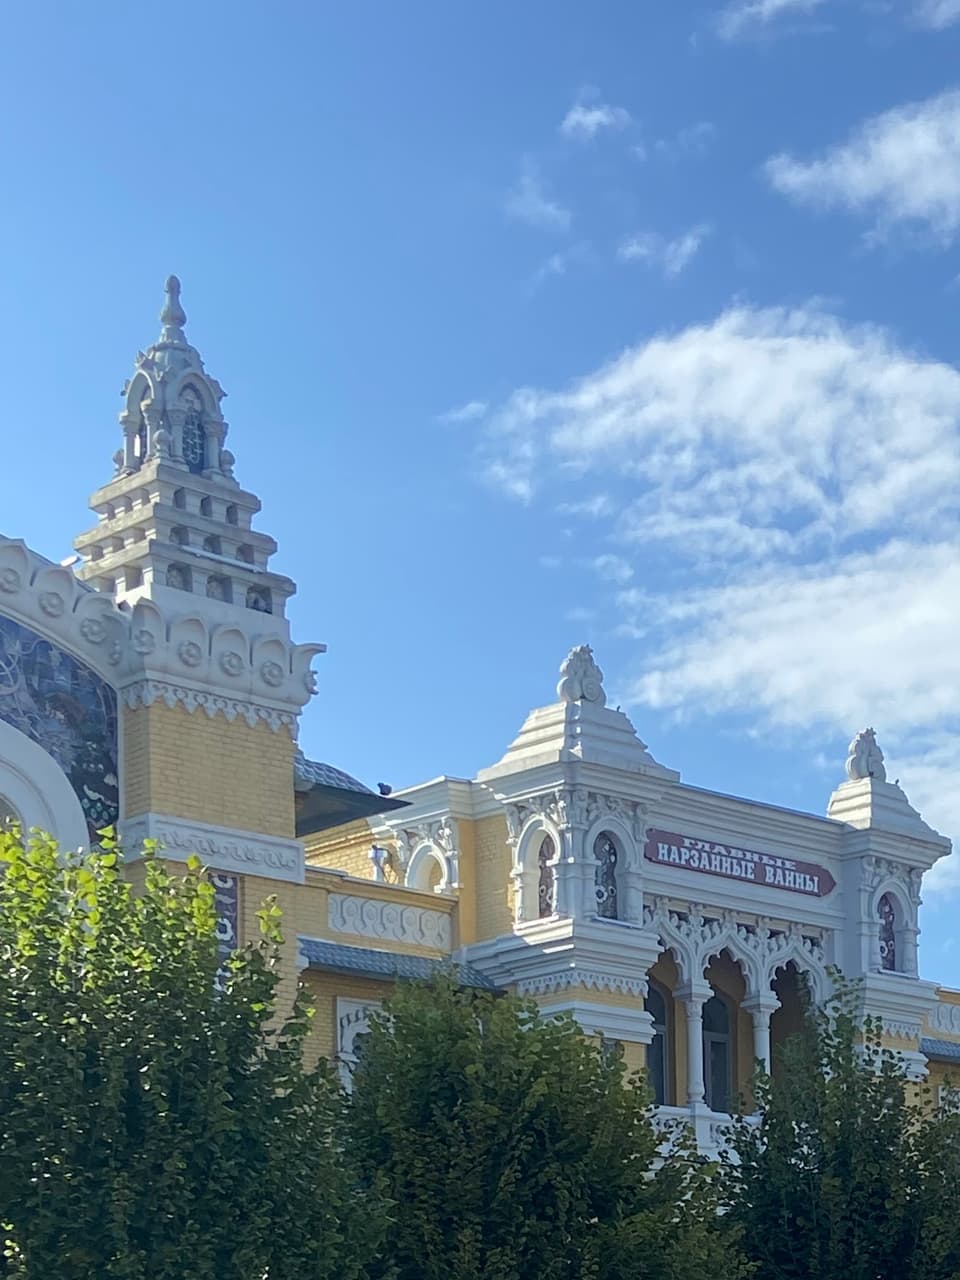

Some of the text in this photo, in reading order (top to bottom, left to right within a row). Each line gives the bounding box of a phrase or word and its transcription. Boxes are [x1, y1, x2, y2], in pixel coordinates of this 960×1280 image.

[657, 842, 820, 893] НАРЗАННЫЕ ВАННЫ
[682, 837, 796, 870] ГЛАВНЫЕ
